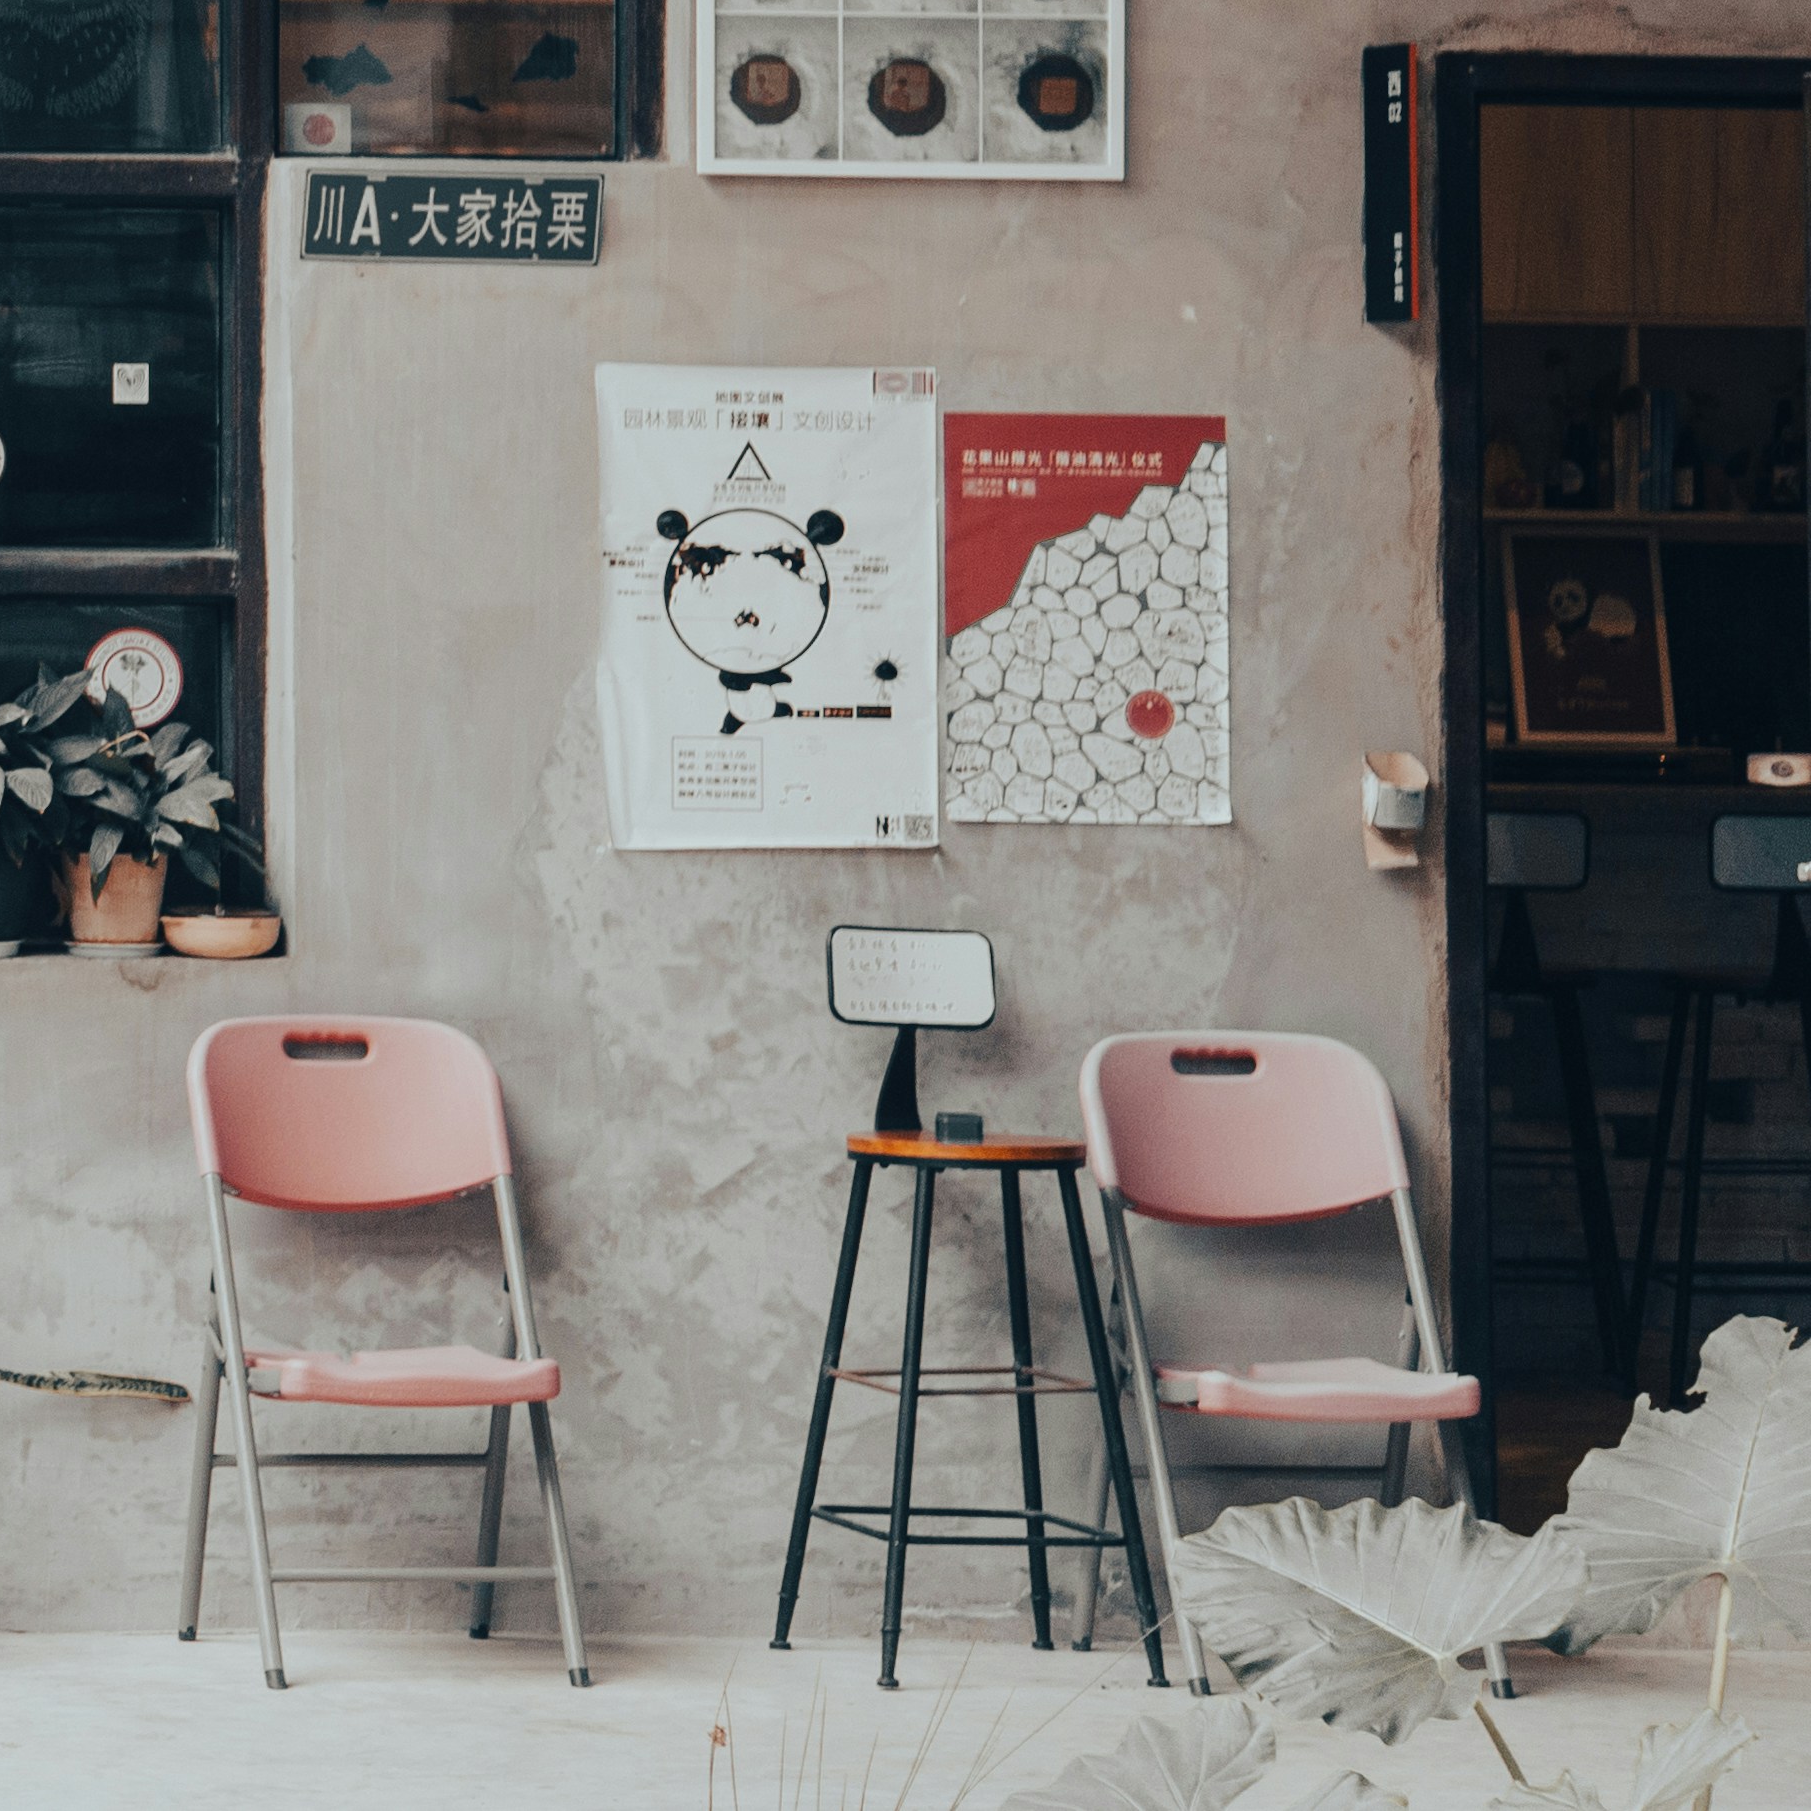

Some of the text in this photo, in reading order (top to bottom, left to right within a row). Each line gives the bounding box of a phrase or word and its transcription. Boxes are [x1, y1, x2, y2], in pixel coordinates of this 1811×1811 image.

[313, 184, 587, 251] 川A·大家拾栗
